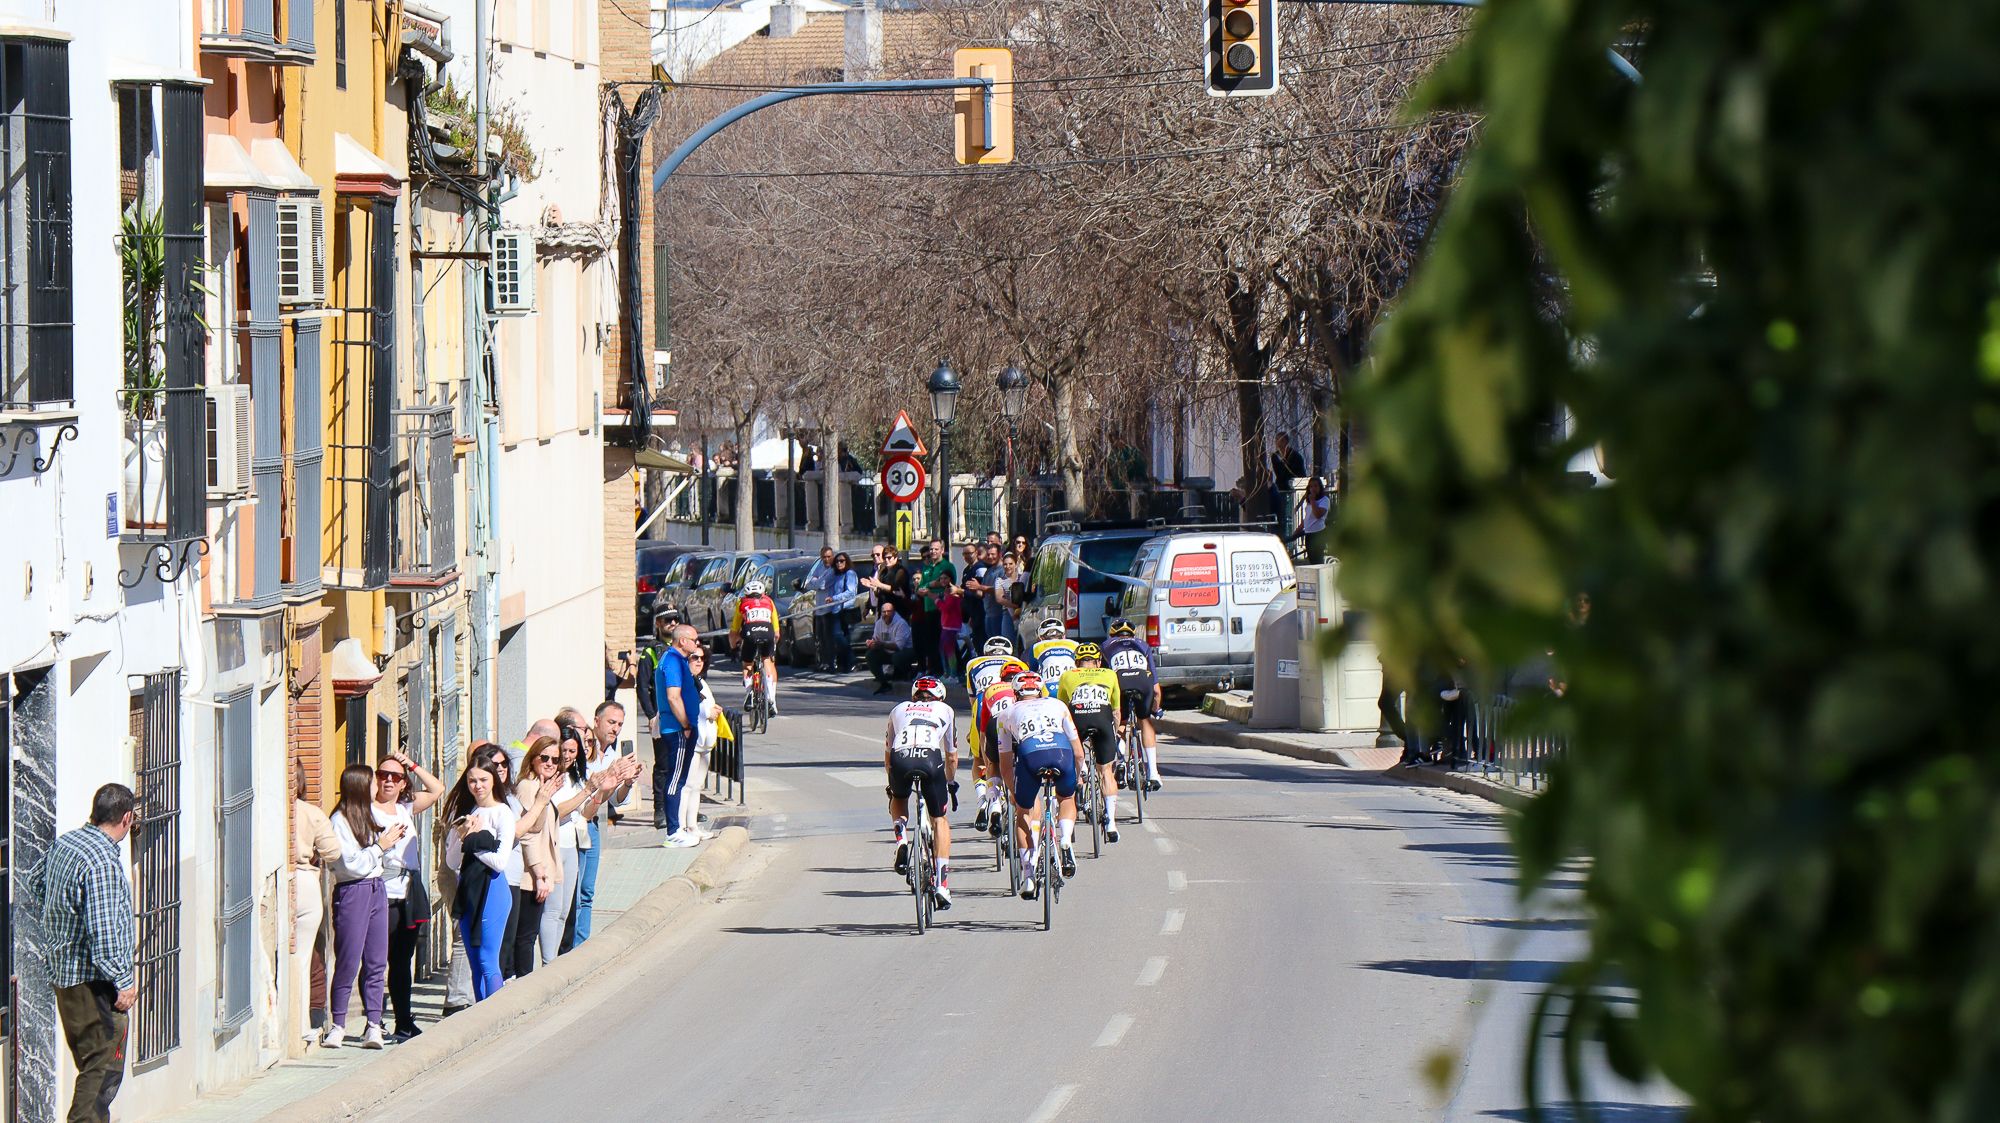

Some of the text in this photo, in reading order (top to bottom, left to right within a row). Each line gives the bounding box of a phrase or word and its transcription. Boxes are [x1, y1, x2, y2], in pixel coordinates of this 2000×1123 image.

[891, 469, 916, 486] 30
[1176, 624, 1197, 633] 2946
[1114, 653, 1145, 667] 45 45
[1043, 665, 1061, 680] 105
[976, 675, 994, 688] 102
[996, 699, 1008, 712] 16
[1020, 719, 1036, 736] 36
[901, 729, 932, 745] 3 3
